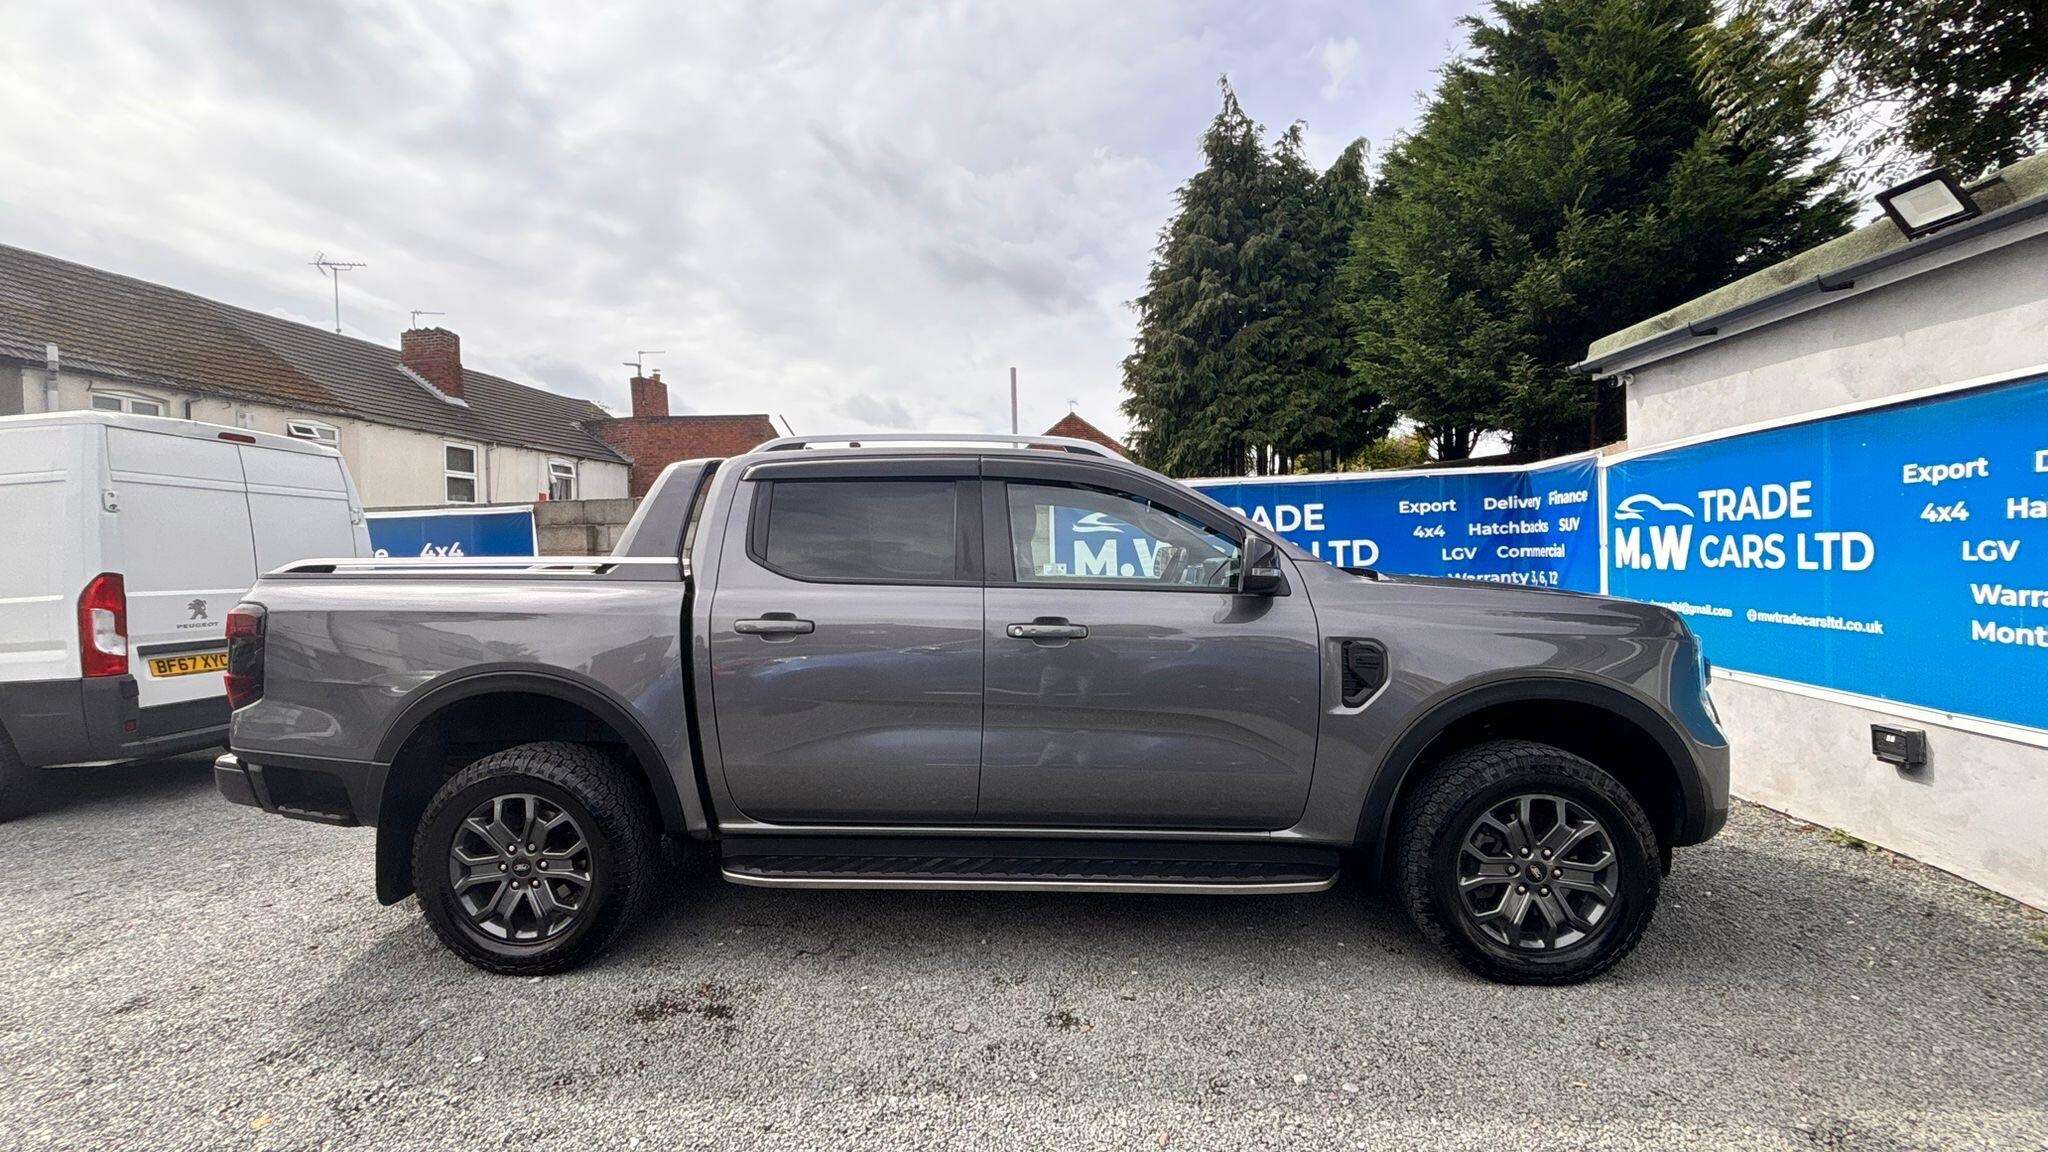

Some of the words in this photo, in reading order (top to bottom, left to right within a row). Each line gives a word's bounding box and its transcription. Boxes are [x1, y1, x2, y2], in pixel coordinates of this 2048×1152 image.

[1903, 457, 1989, 486] Export
[1399, 499, 1457, 515] Export
[1484, 495, 1541, 511] Delivery
[1548, 490, 1588, 506] Finance
[1698, 480, 1812, 522] TRADE
[1920, 500, 1969, 522] 4x4
[1413, 524, 1446, 538] 4x4
[1468, 519, 1549, 536] Hatchbacks
[1559, 517, 1580, 532] SUV
[420, 542, 464, 558] 4x4
[1441, 547, 1477, 561] LGV
[1496, 542, 1565, 558] Commercial
[1615, 524, 1693, 570] M.W
[1700, 533, 1786, 570] CARS
[1797, 532, 1875, 571] LTD
[1962, 539, 2020, 562] LGV
[176, 621, 219, 629] PEUGEOT
[1757, 611, 1884, 634] mwtradecarsltd.co.uk
[155, 656, 197, 674] BF67
